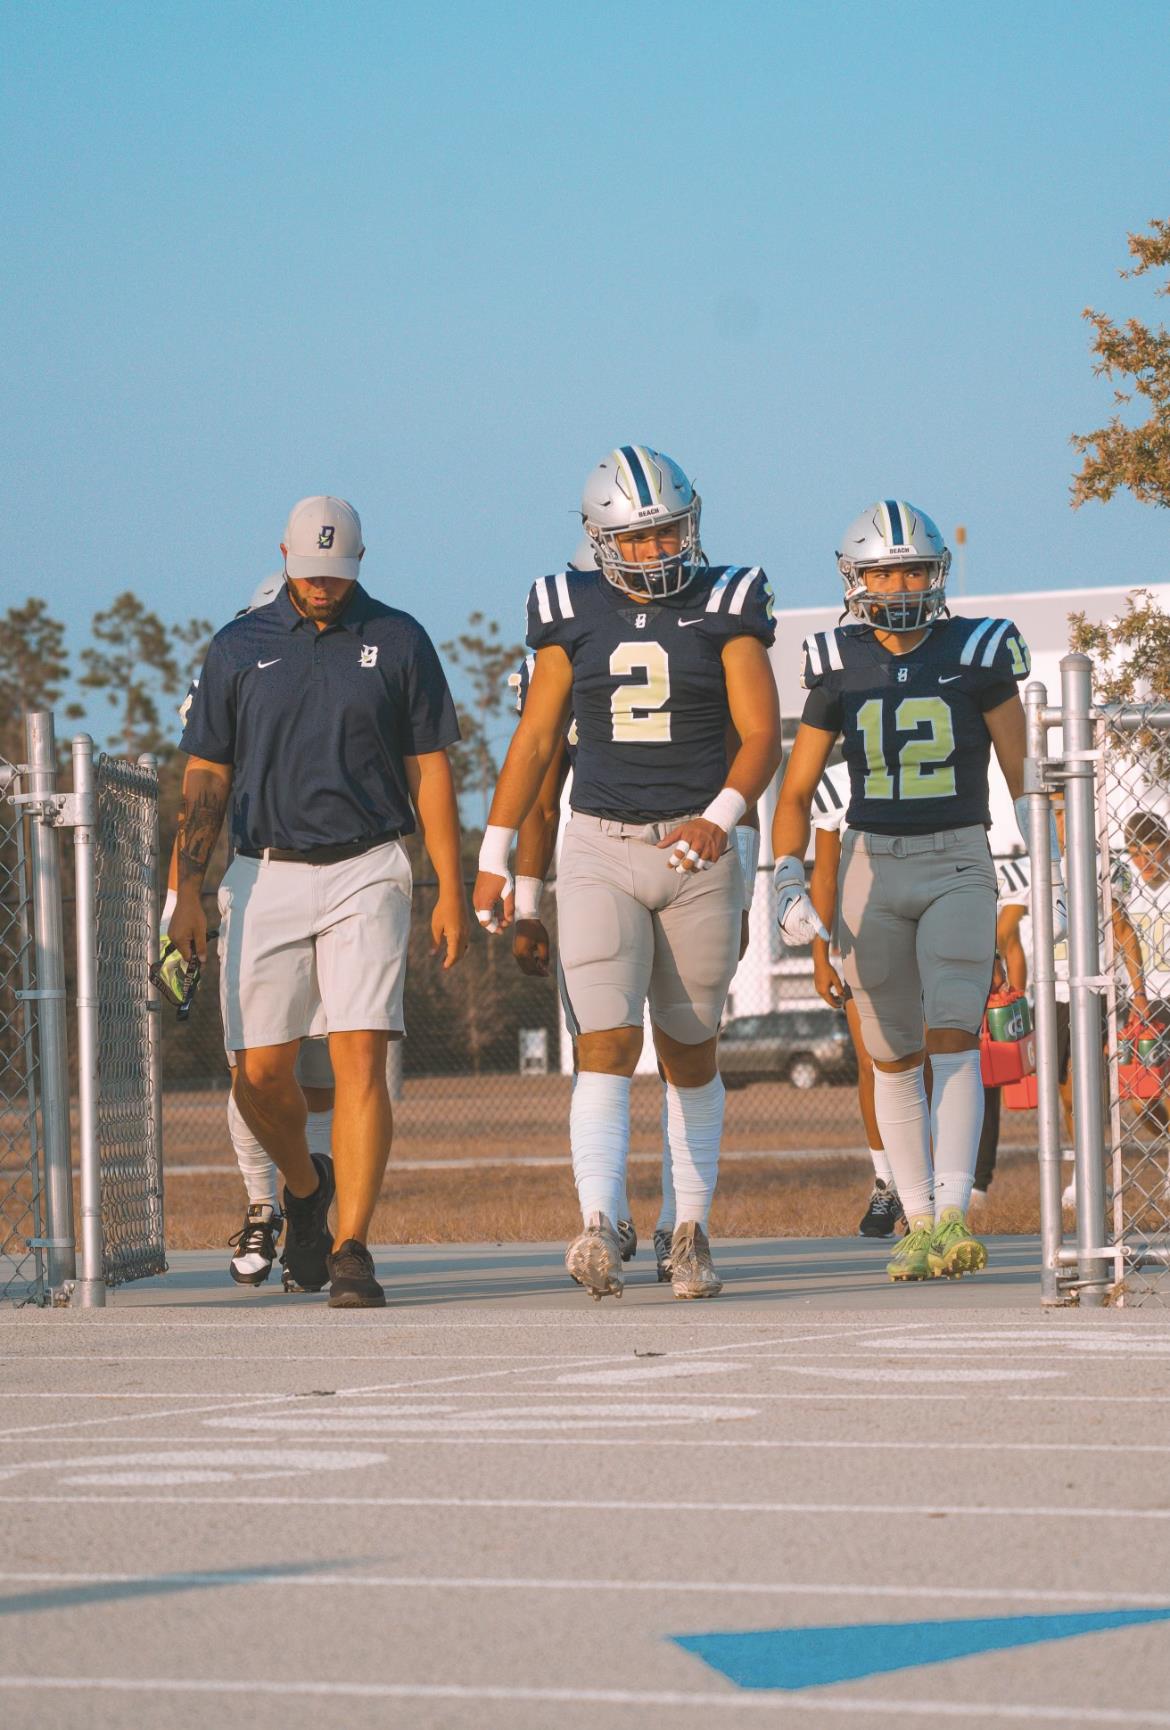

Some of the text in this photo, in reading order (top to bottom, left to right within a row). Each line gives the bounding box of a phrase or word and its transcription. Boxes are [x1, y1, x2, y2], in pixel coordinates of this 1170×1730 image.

[638, 507, 660, 517] BEACH
[609, 641, 671, 742] 2
[856, 696, 957, 800] 12
